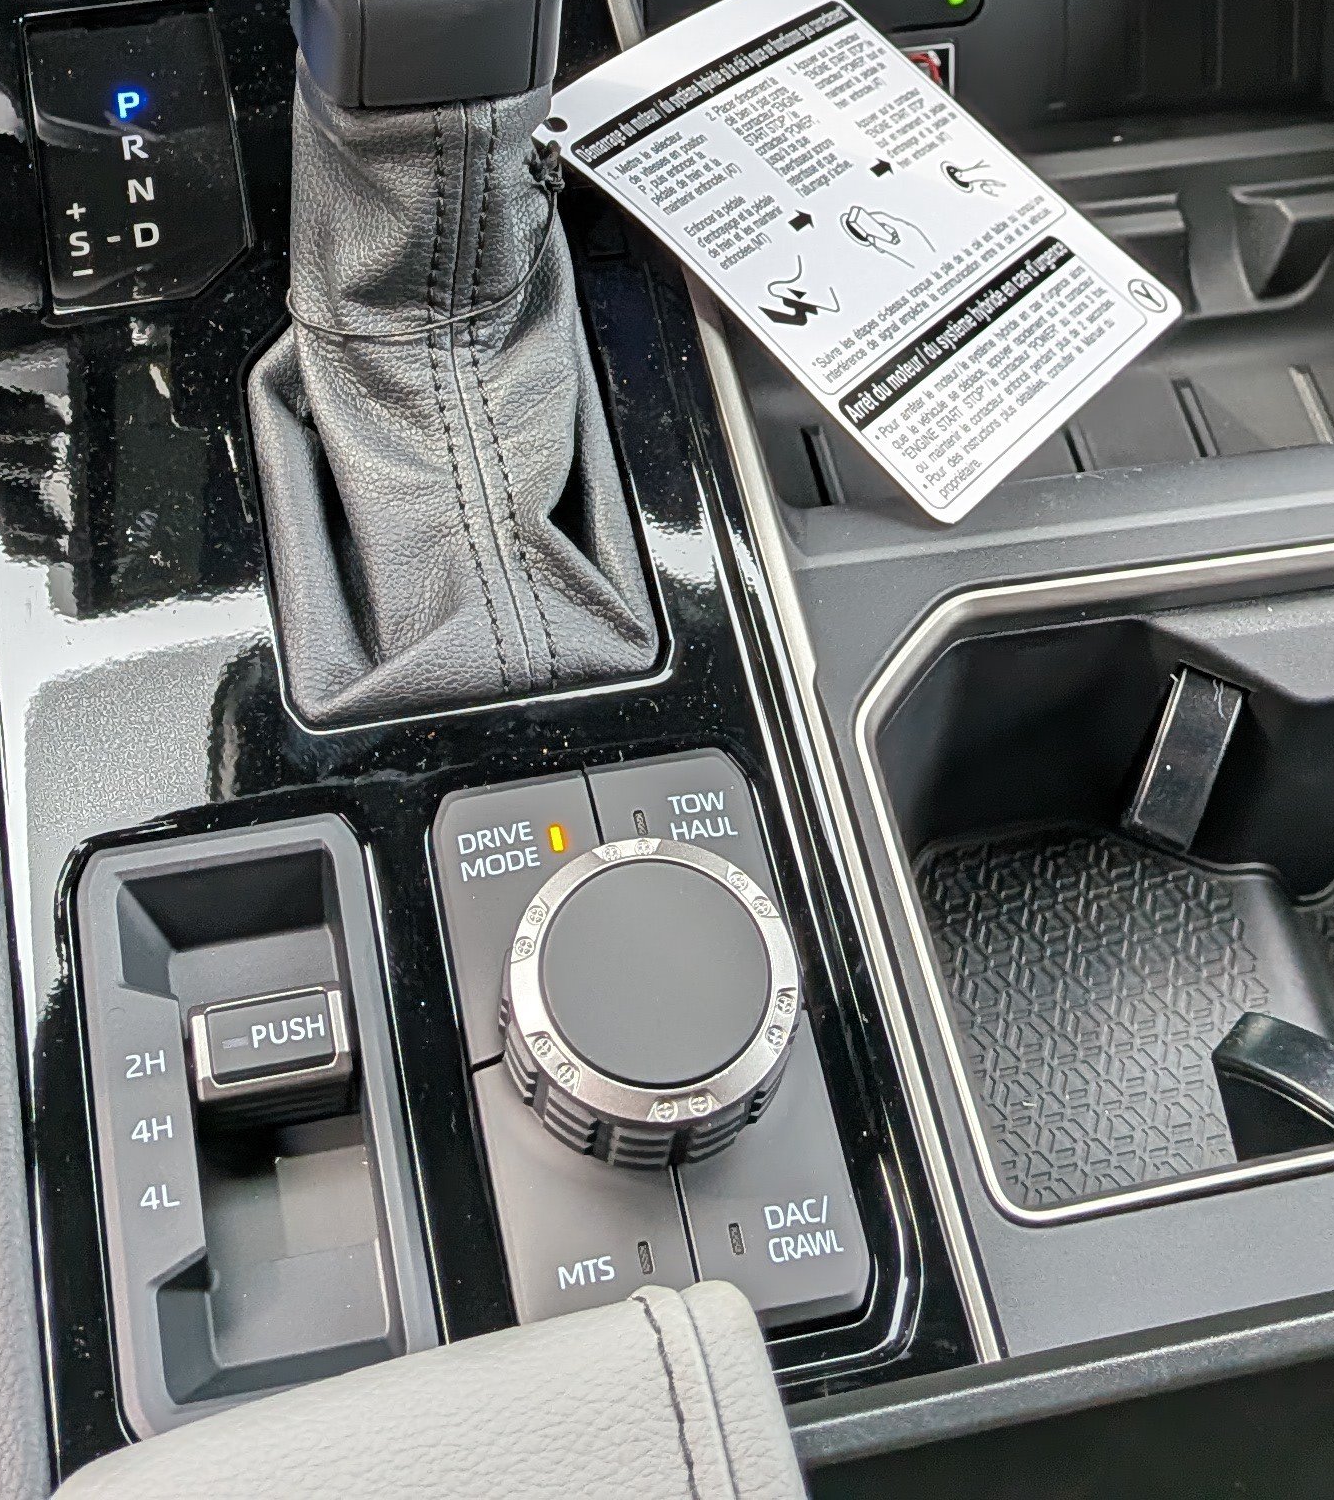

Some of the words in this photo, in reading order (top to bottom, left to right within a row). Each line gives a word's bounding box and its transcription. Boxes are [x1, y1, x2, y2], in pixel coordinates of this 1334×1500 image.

[116, 92, 141, 119] P
[122, 134, 149, 161] R
[574, 129, 627, 163] Démarrage
[129, 177, 155, 204] N
[69, 232, 91, 258] S
[133, 222, 160, 249] D
[843, 390, 880, 424] Arrêt
[870, 381, 894, 402] du
[885, 354, 925, 391] moteur
[921, 341, 943, 360] du
[935, 313, 978, 350] système
[877, 417, 901, 439] Pour
[923, 465, 948, 487] Pour
[668, 790, 727, 817] TOW
[456, 821, 535, 856] DRIVE
[669, 813, 739, 842] HAUL
[459, 850, 542, 883] MODE
[250, 1012, 327, 1050] PUSH
[124, 1050, 168, 1080] 2H
[130, 1114, 175, 1144] 4H
[139, 1184, 181, 1211] 4L
[764, 1197, 831, 1232] DAC/
[767, 1227, 845, 1266] CRAWL
[557, 1256, 616, 1291] MTS
